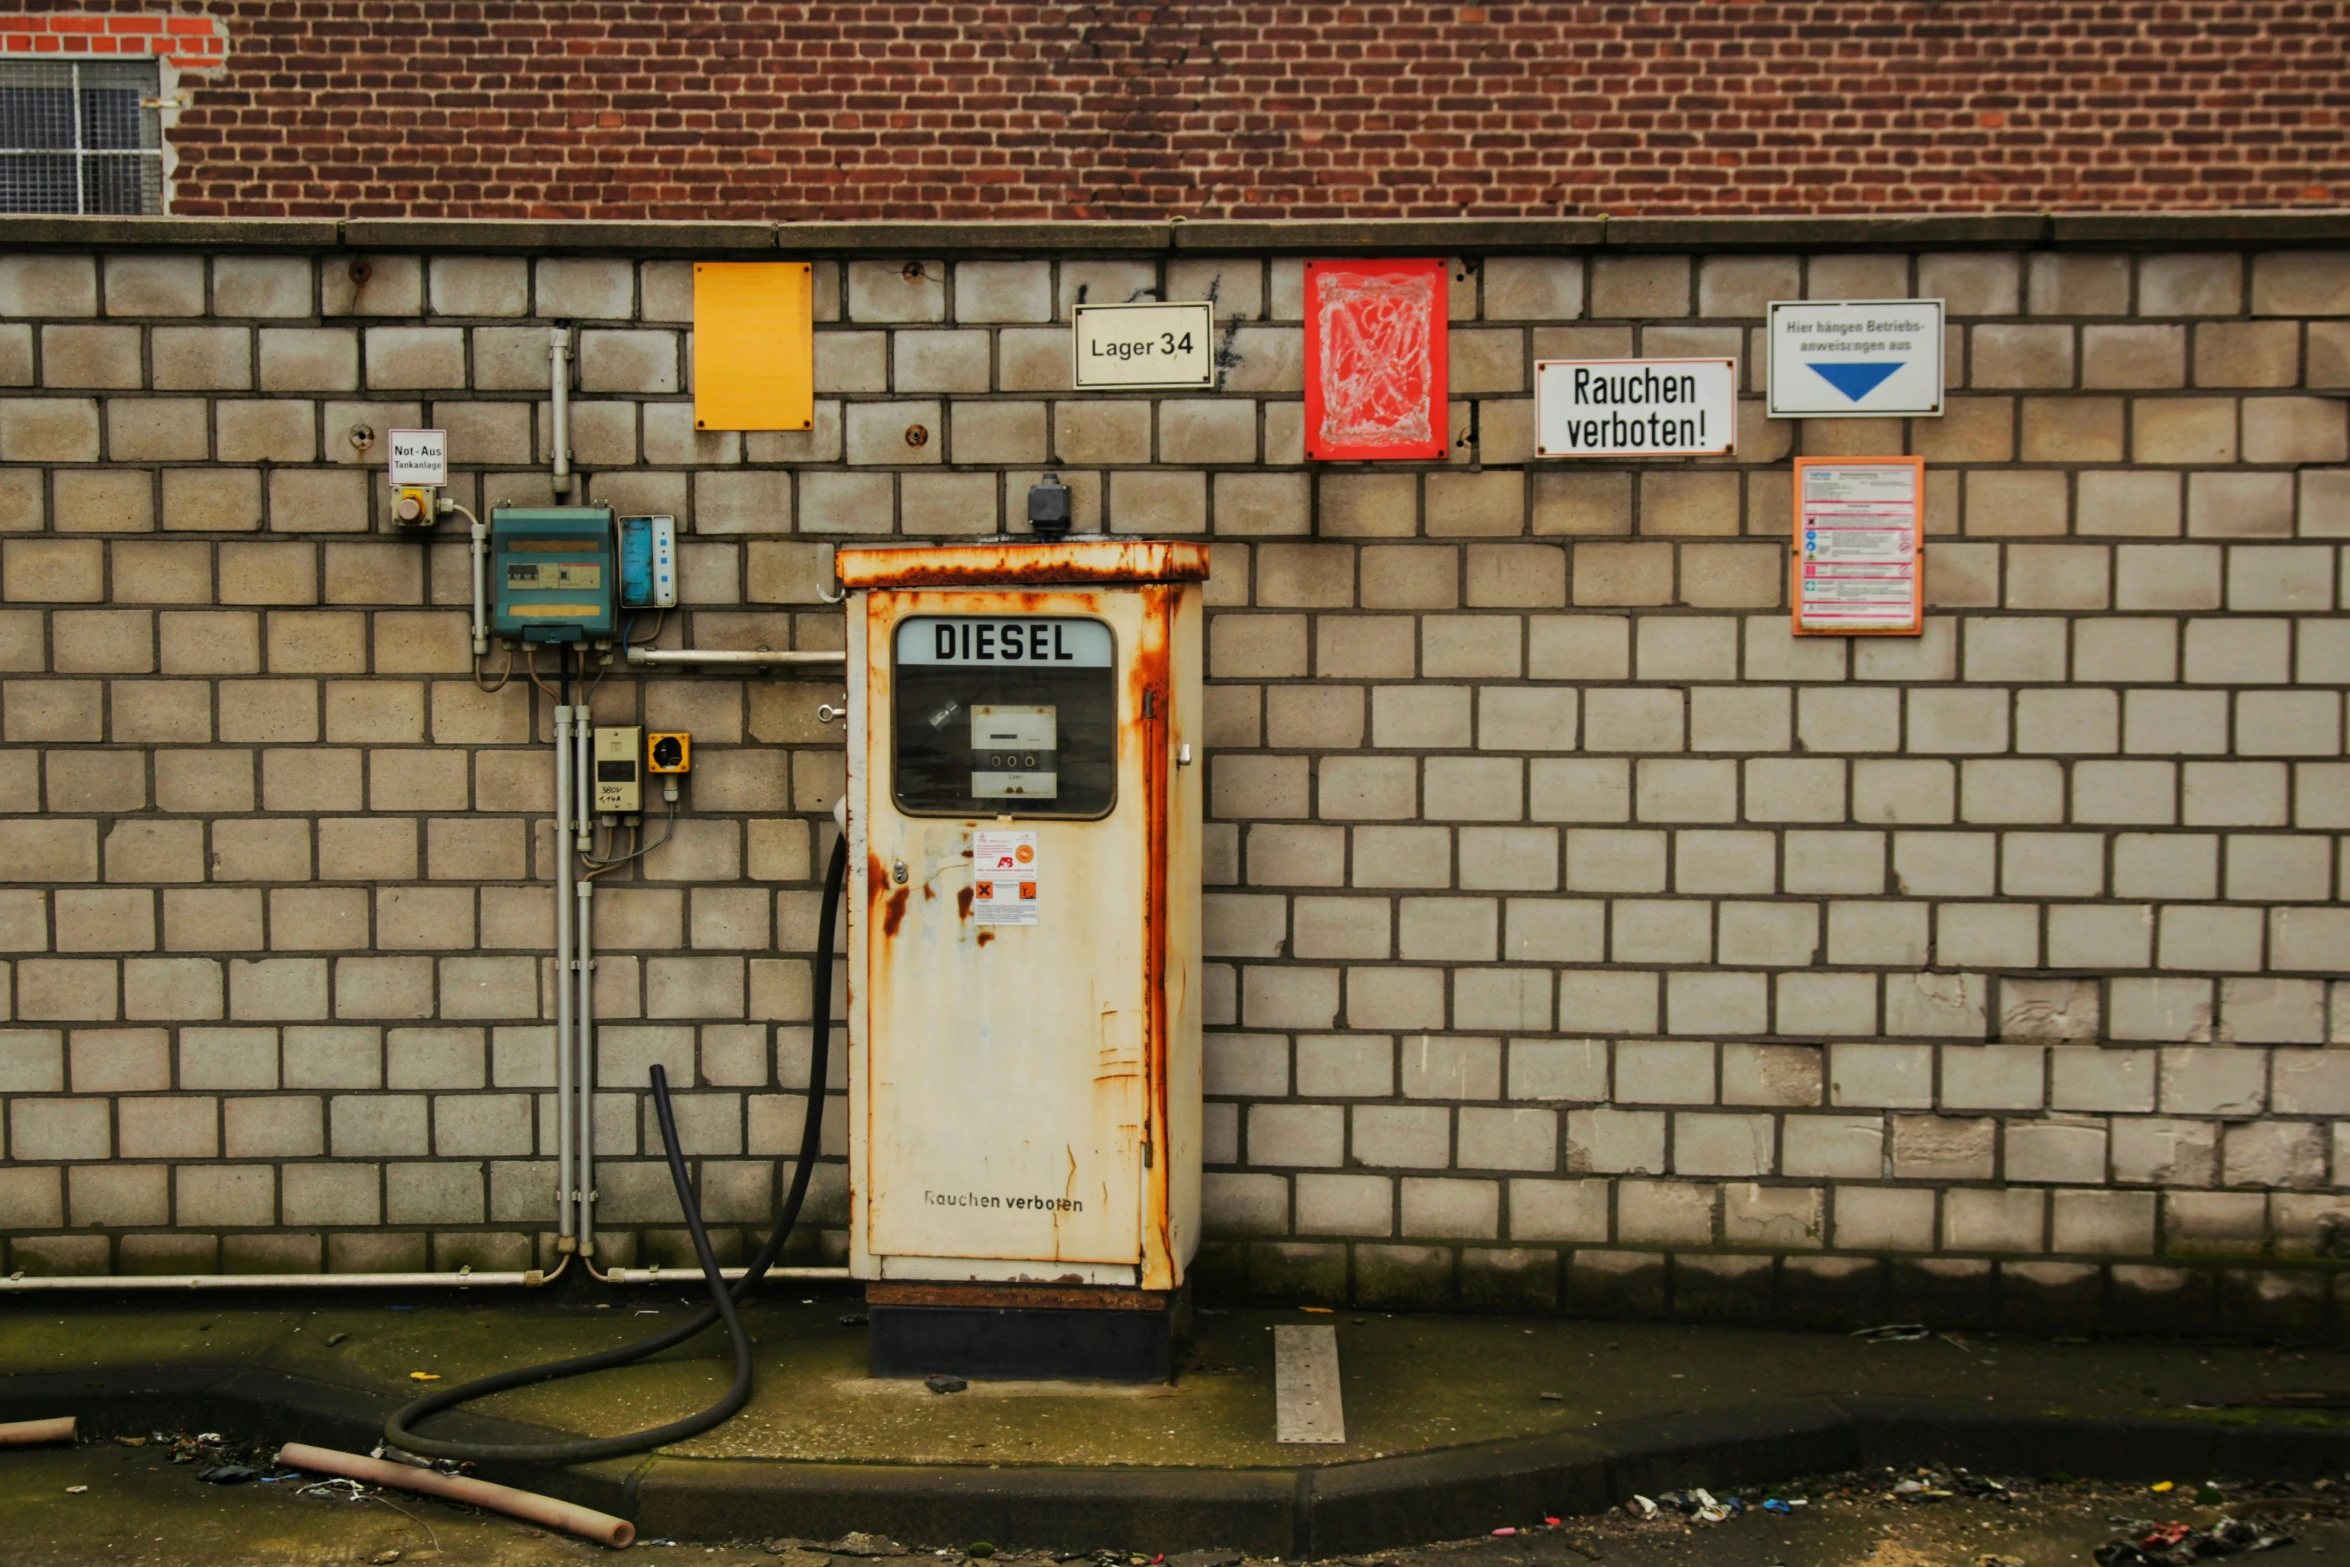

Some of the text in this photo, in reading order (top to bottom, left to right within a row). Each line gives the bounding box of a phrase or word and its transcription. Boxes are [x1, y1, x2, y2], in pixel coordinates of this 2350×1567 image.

[1787, 319, 1925, 336] Hier hängen Betriebs-
[1091, 332, 1193, 361] Lager 34
[1888, 340, 1911, 351] aus
[1574, 367, 1695, 405] Rauchen
[1567, 409, 1706, 448] verboten!
[394, 460, 442, 471] Tankanlage
[935, 624, 1073, 660] DIESEL
[600, 786, 624, 794] 380V
[924, 1190, 1083, 1212] Rauchen verboten
